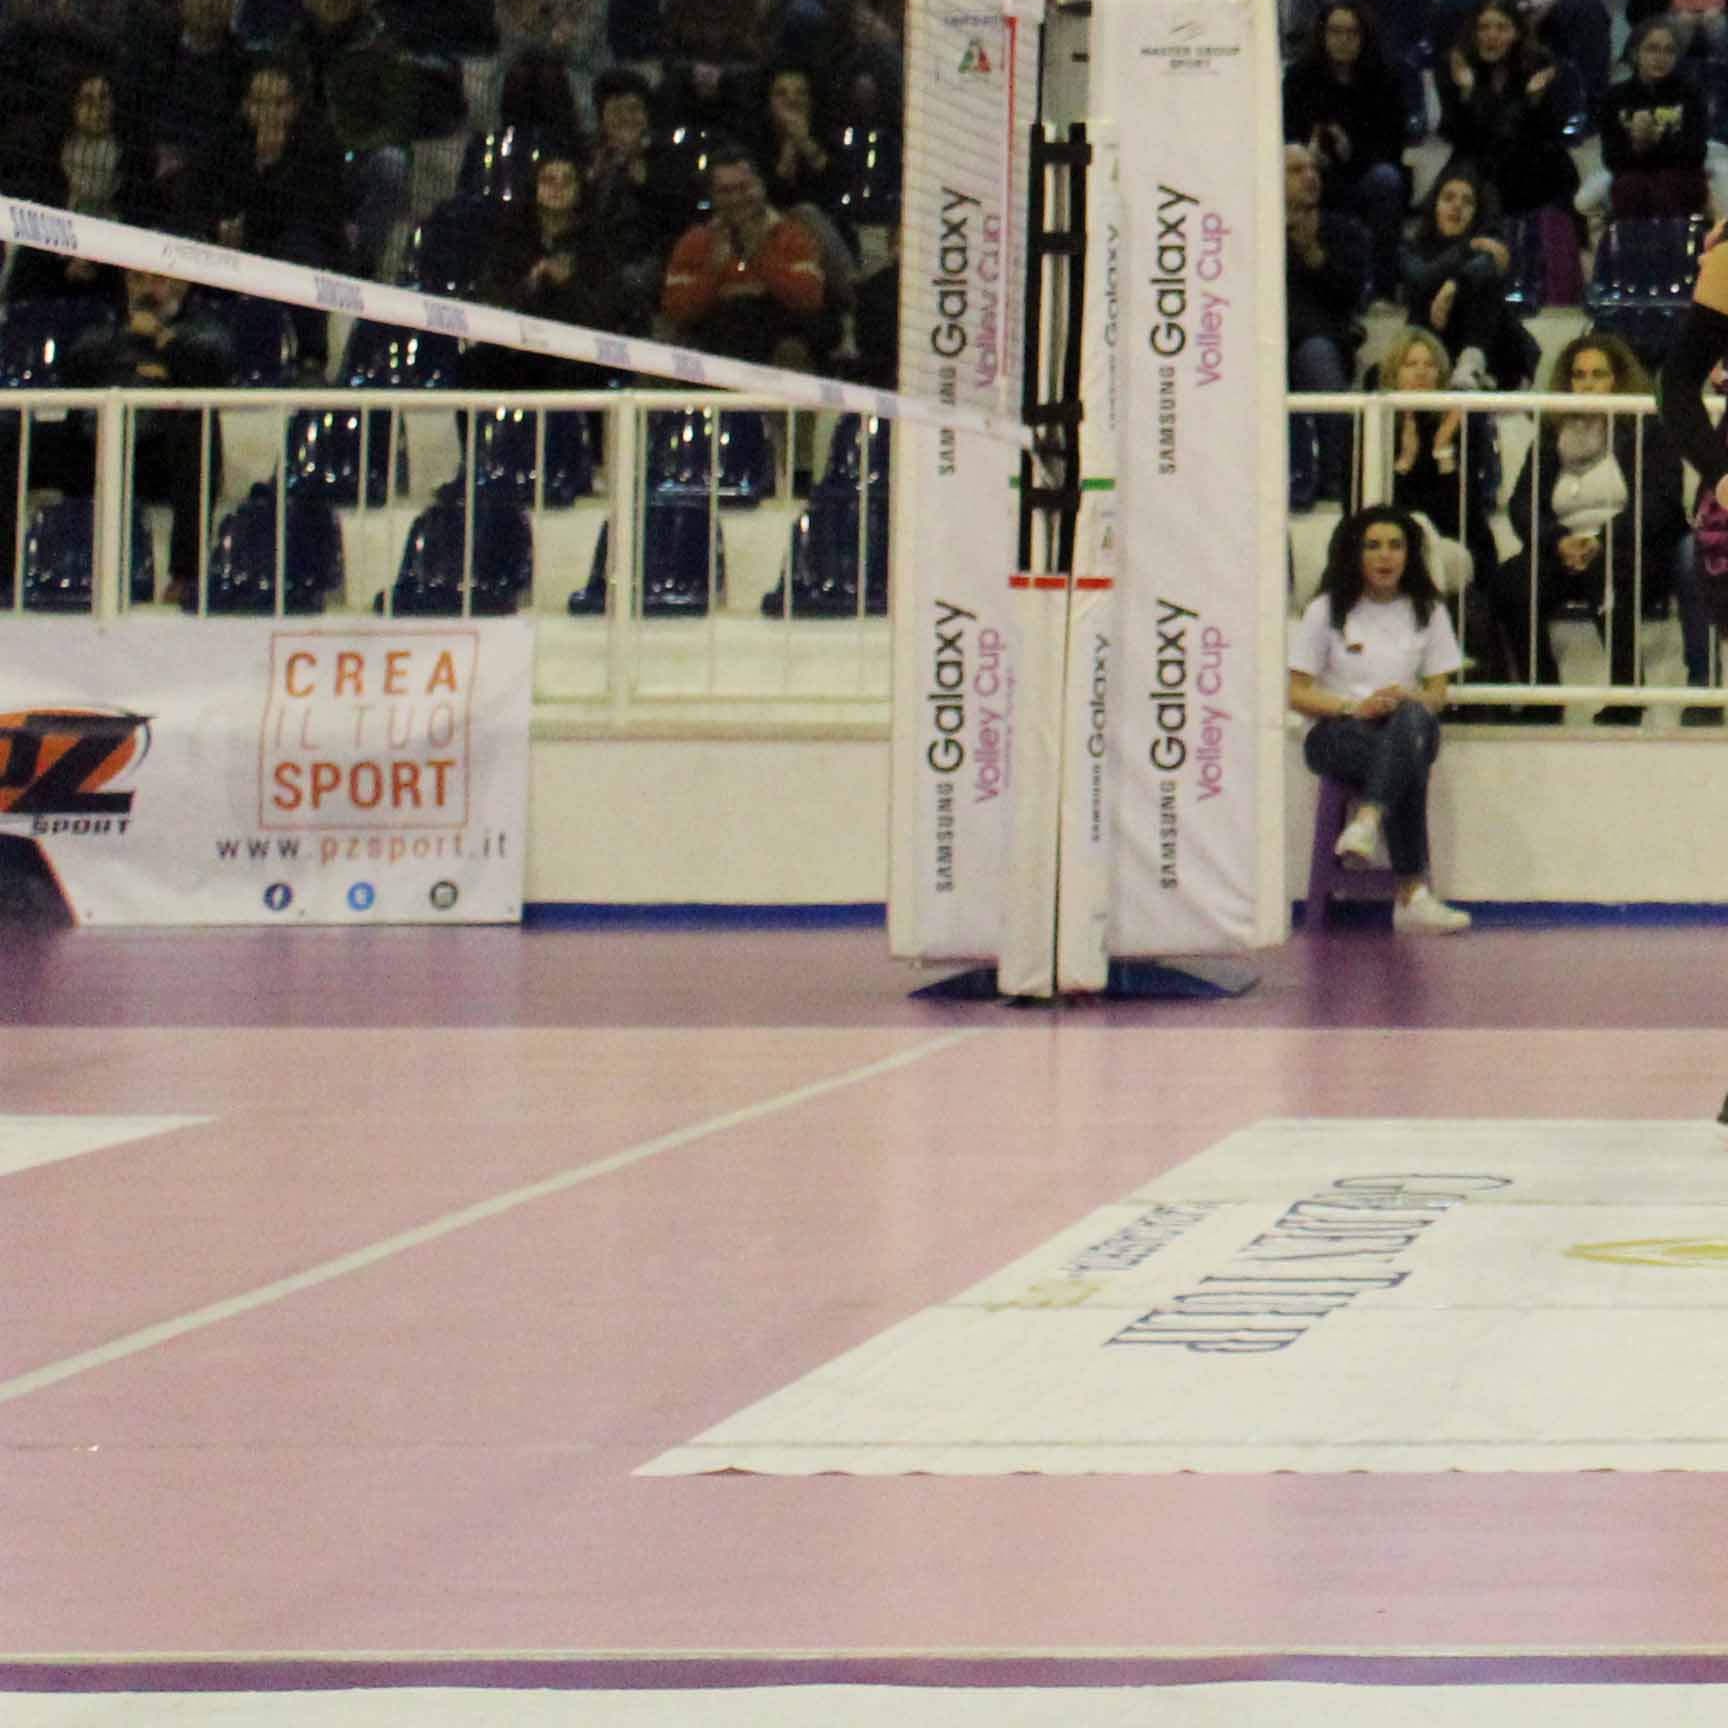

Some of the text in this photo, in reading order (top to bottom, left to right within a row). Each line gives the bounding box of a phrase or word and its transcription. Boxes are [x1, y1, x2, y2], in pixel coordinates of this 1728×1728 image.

[931, 186, 982, 359] Galaxy
[1150, 184, 1200, 476] SAMSUNG Galaxy
[1196, 211, 1232, 388] Volley Cup
[272, 703, 457, 751] IL TUO
[285, 651, 458, 698] CREA
[928, 599, 977, 893] SAMSUNG Galaxy
[972, 627, 1007, 805] Volley Cup
[1150, 598, 1199, 891] SAMSUNG Galaxy
[1196, 625, 1232, 803] Volley Cup
[215, 829, 507, 865] www.pzsport.it
[272, 760, 457, 811] SPORT
